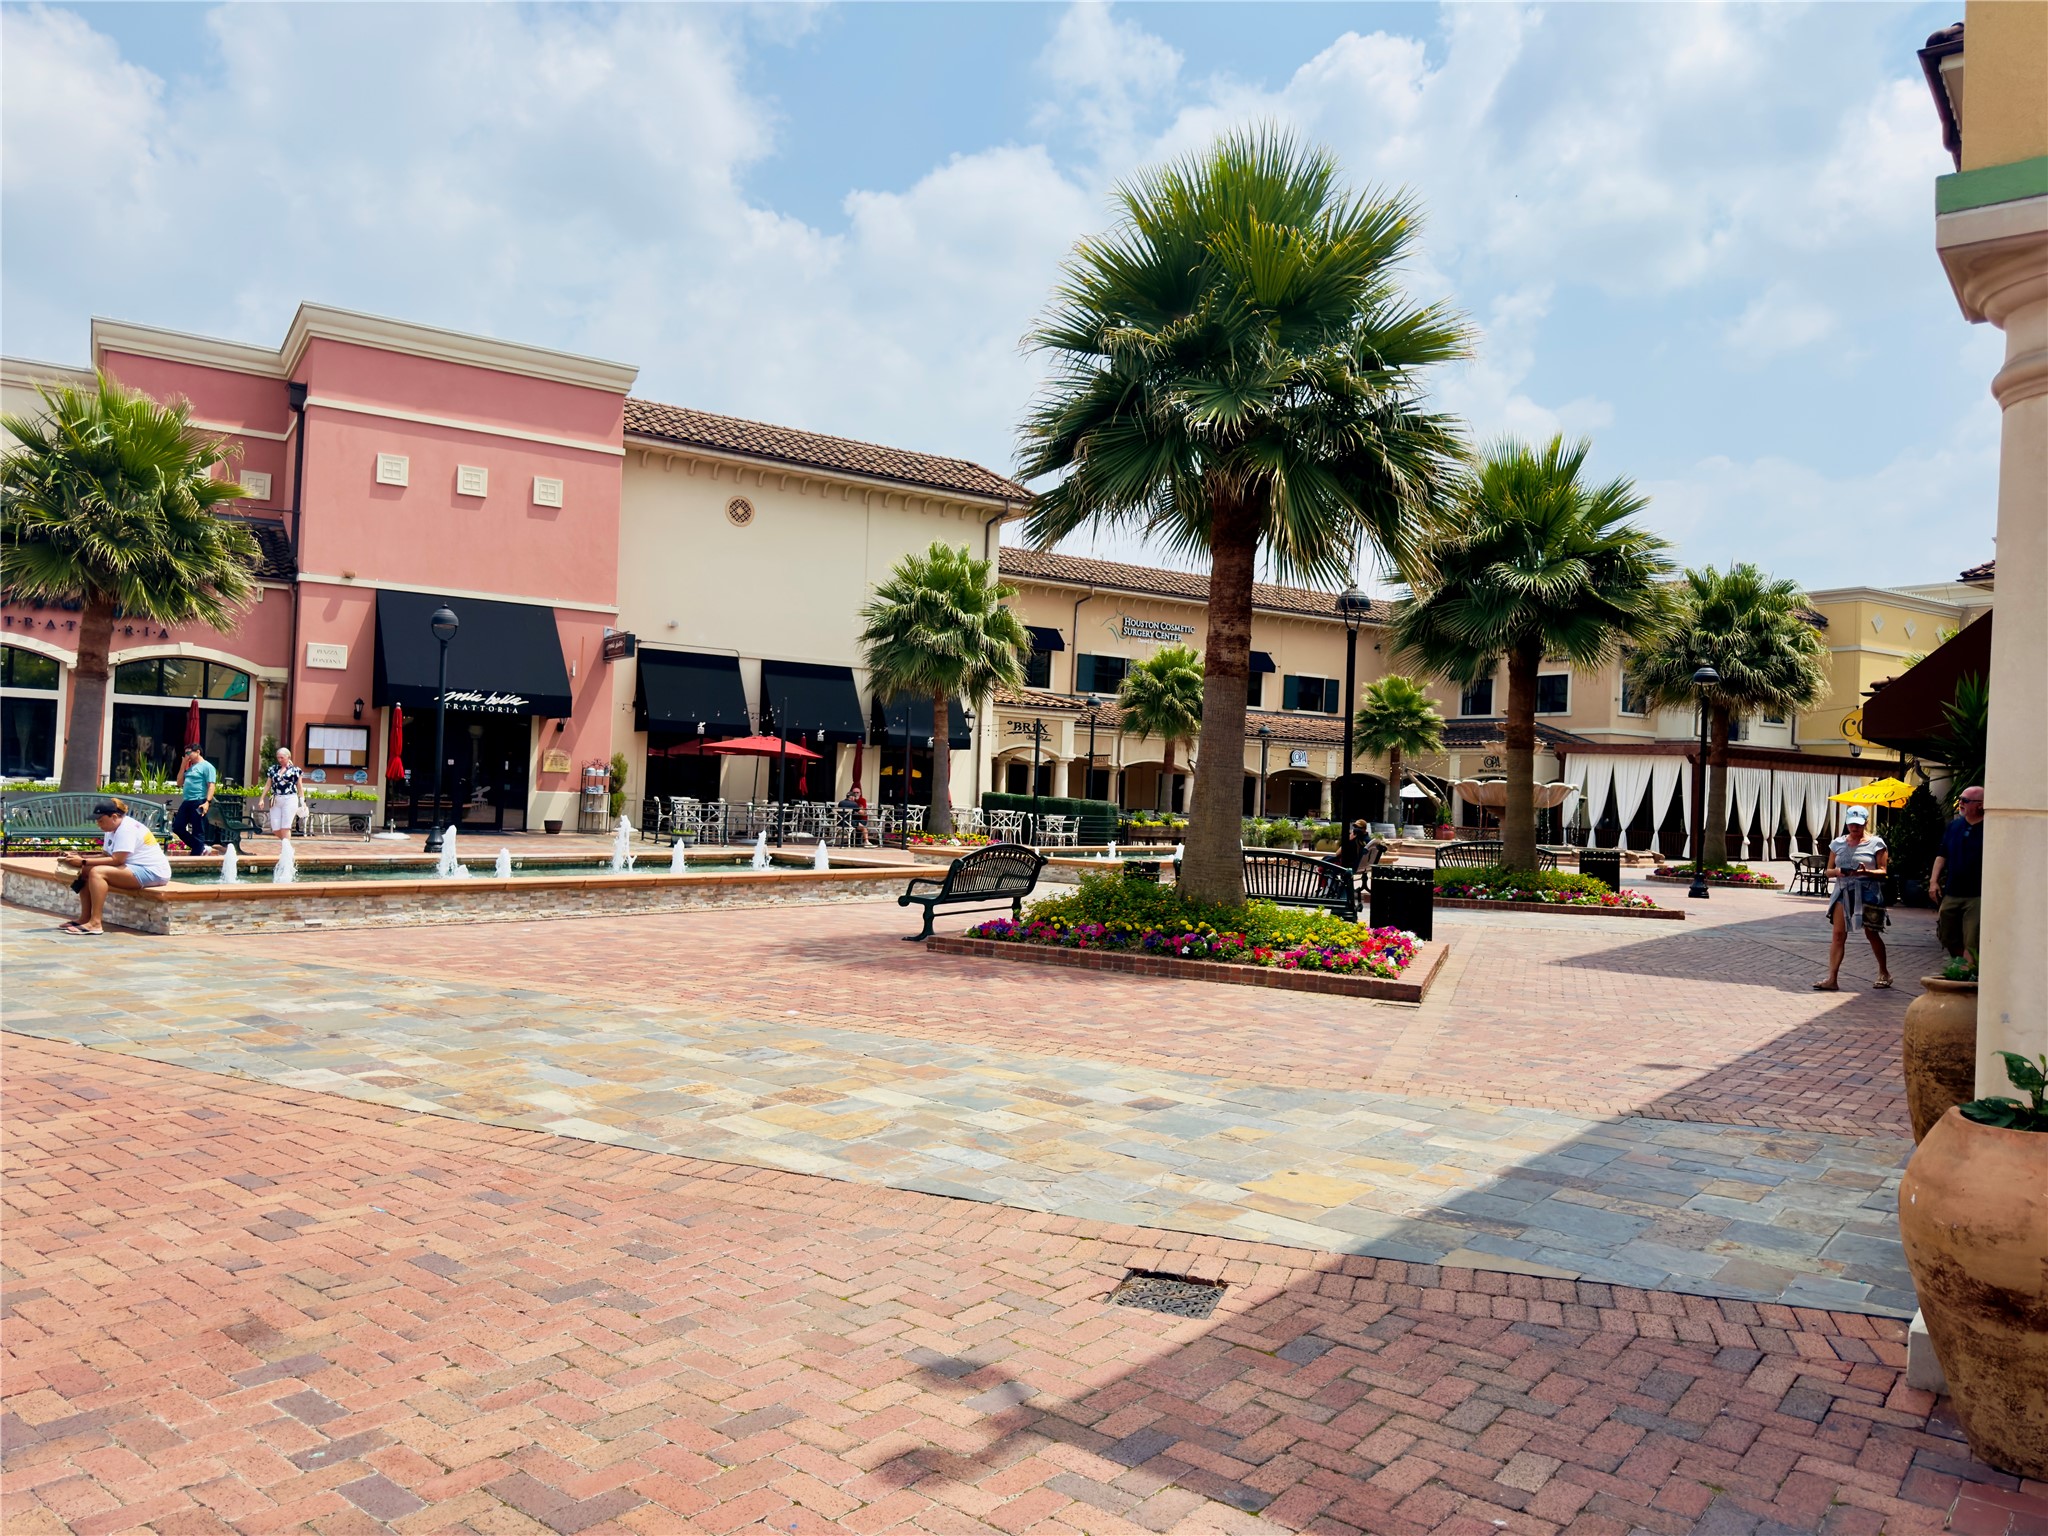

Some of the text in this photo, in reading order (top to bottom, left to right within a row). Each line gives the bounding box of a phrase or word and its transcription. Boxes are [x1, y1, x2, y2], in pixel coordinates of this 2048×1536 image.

[1123, 617, 1196, 634] HOUSTON COSMETIC
[1123, 626, 1182, 642] SURGERY CENTER
